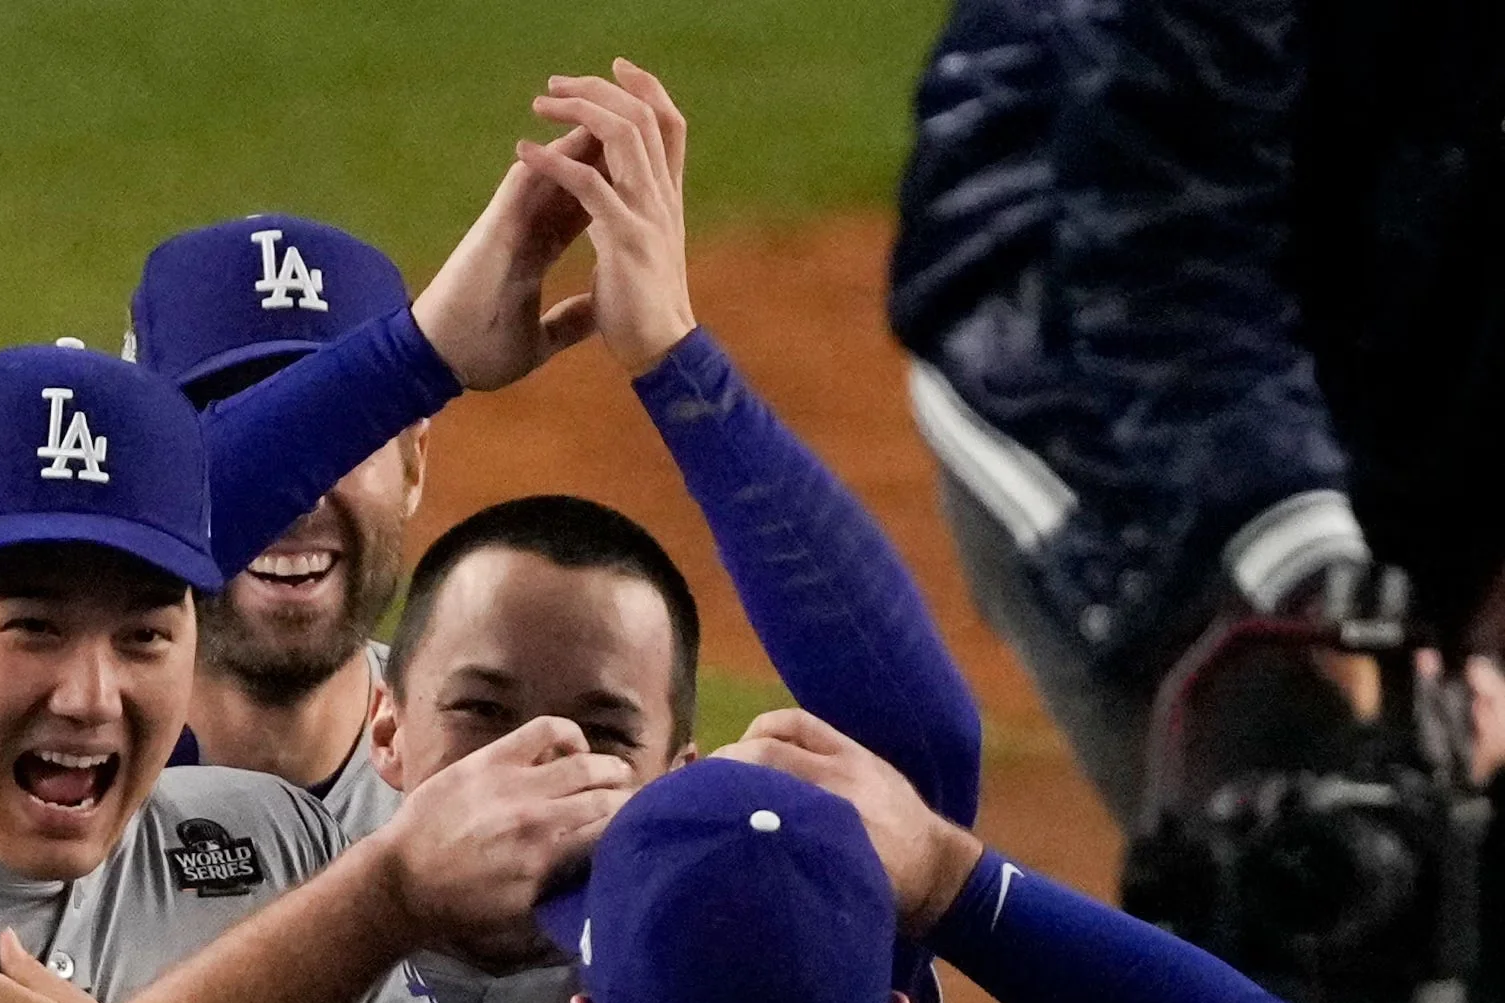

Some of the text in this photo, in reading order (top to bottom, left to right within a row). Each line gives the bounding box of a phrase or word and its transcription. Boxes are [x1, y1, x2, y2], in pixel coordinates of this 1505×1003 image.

[251, 229, 329, 311] LA
[37, 387, 110, 483] LA
[174, 846, 252, 868] WORLD
[183, 860, 254, 881] SERIES
